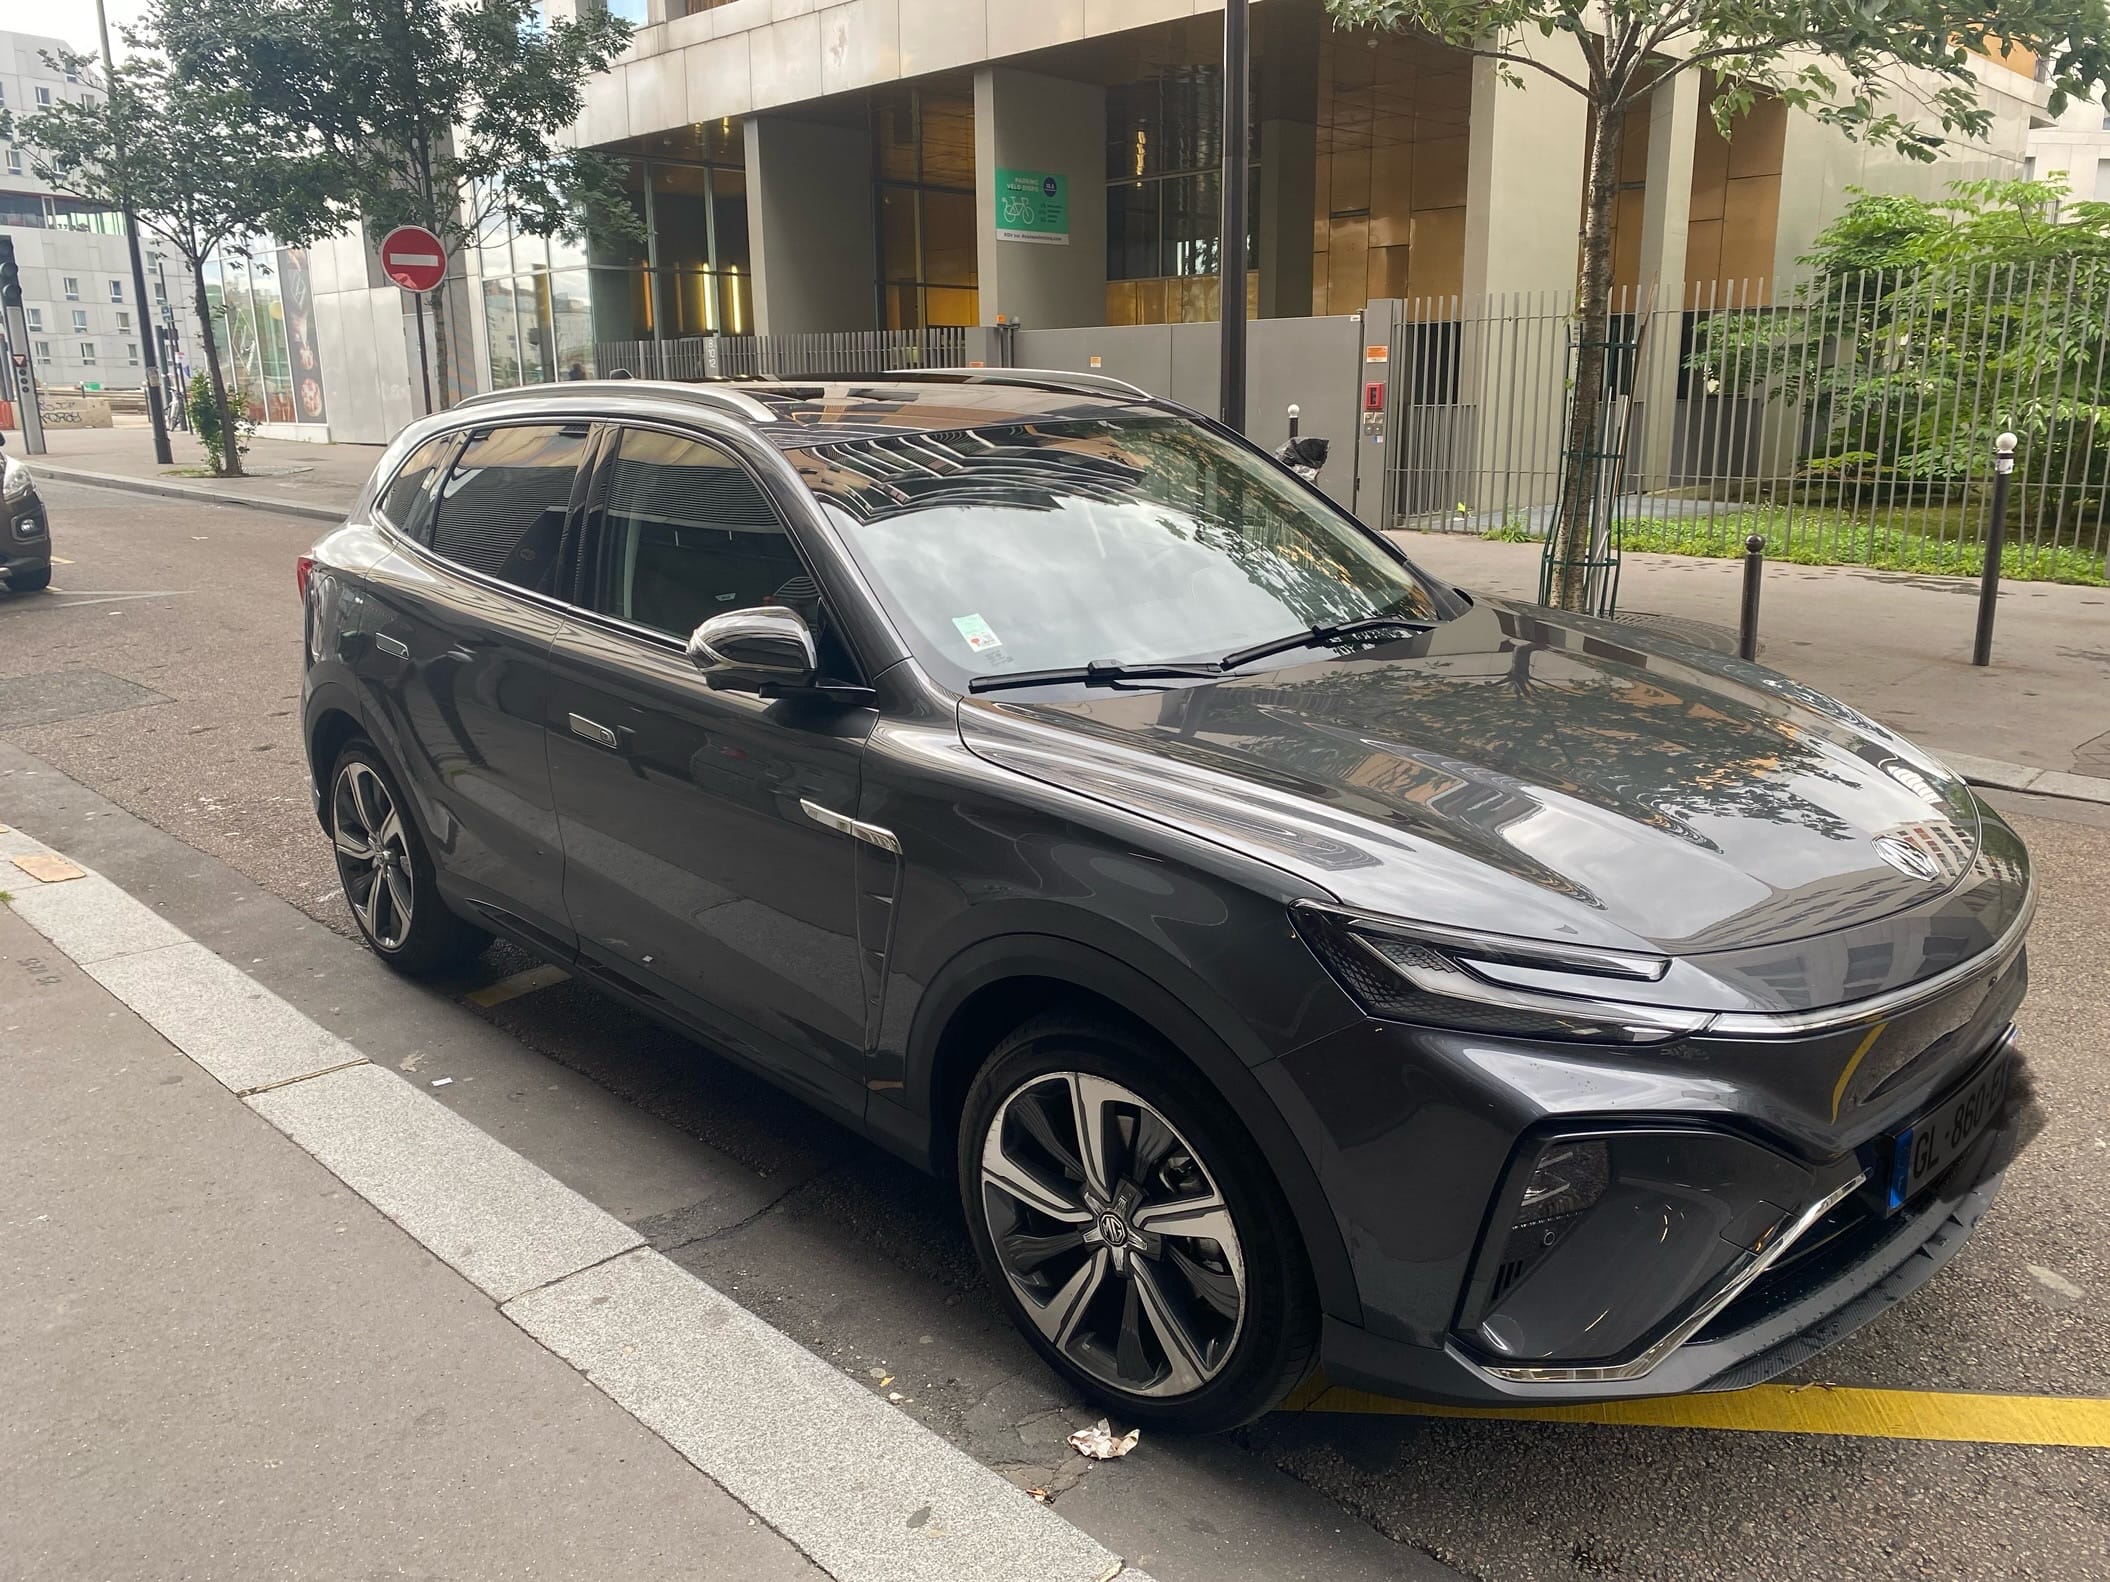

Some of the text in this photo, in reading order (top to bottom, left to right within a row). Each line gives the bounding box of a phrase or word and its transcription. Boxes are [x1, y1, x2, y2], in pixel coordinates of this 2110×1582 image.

[708, 349, 716, 358] 10
[708, 358, 716, 368] 12
[1876, 836, 1934, 879] MG
[1101, 1216, 1123, 1242] MG
